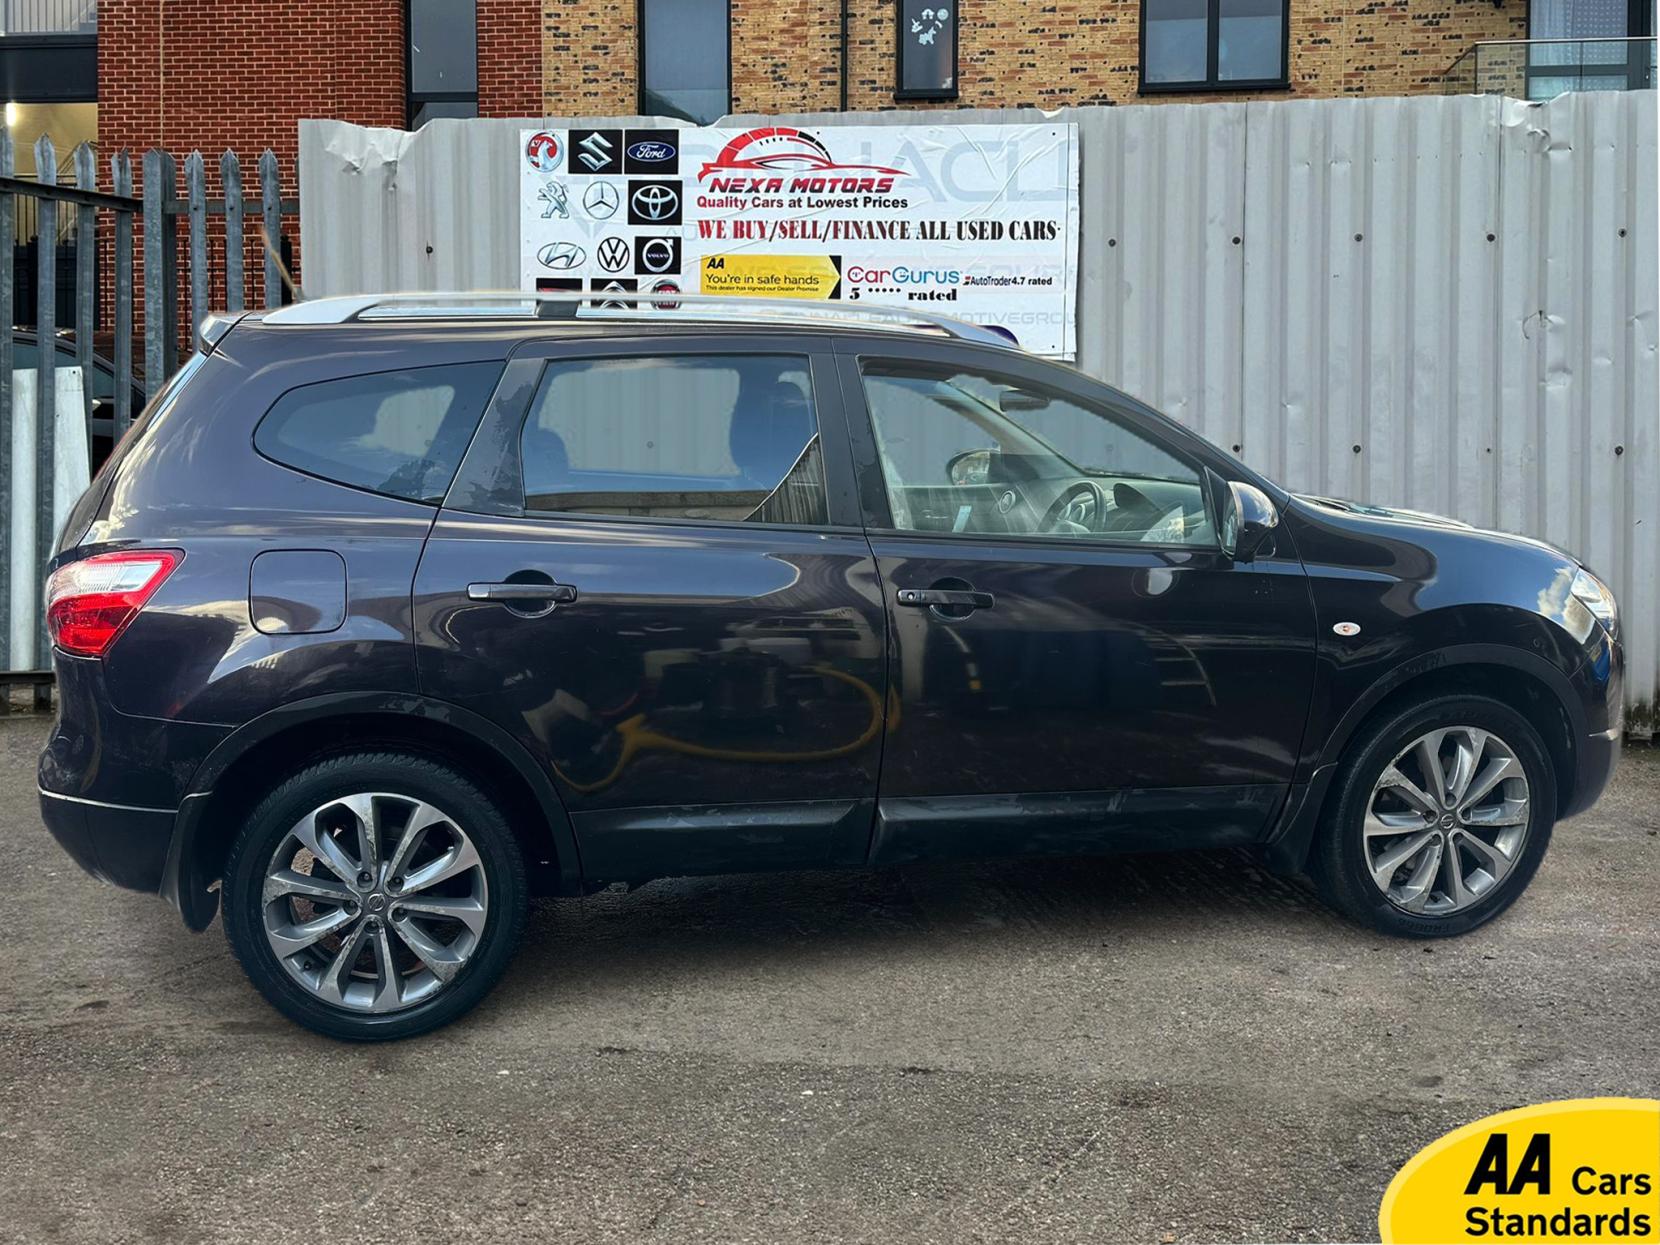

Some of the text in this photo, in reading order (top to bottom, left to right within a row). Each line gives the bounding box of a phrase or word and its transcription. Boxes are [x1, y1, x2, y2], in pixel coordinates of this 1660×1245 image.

[636, 144, 666, 159] Ford
[708, 177, 895, 194] NEXA MOTORS
[697, 195, 909, 211] Quality Cars at Lowest Prices
[697, 219, 727, 240] WE
[732, 219, 911, 243] BUY/SELL/FINANCE
[915, 220, 951, 241] ALL
[956, 220, 1004, 241] USED
[706, 257, 725, 269] AA
[705, 273, 820, 286] You're in safe hands
[847, 265, 960, 284] CarGurus
[1027, 276, 1053, 286] rated
[848, 287, 958, 301] 5 rated
